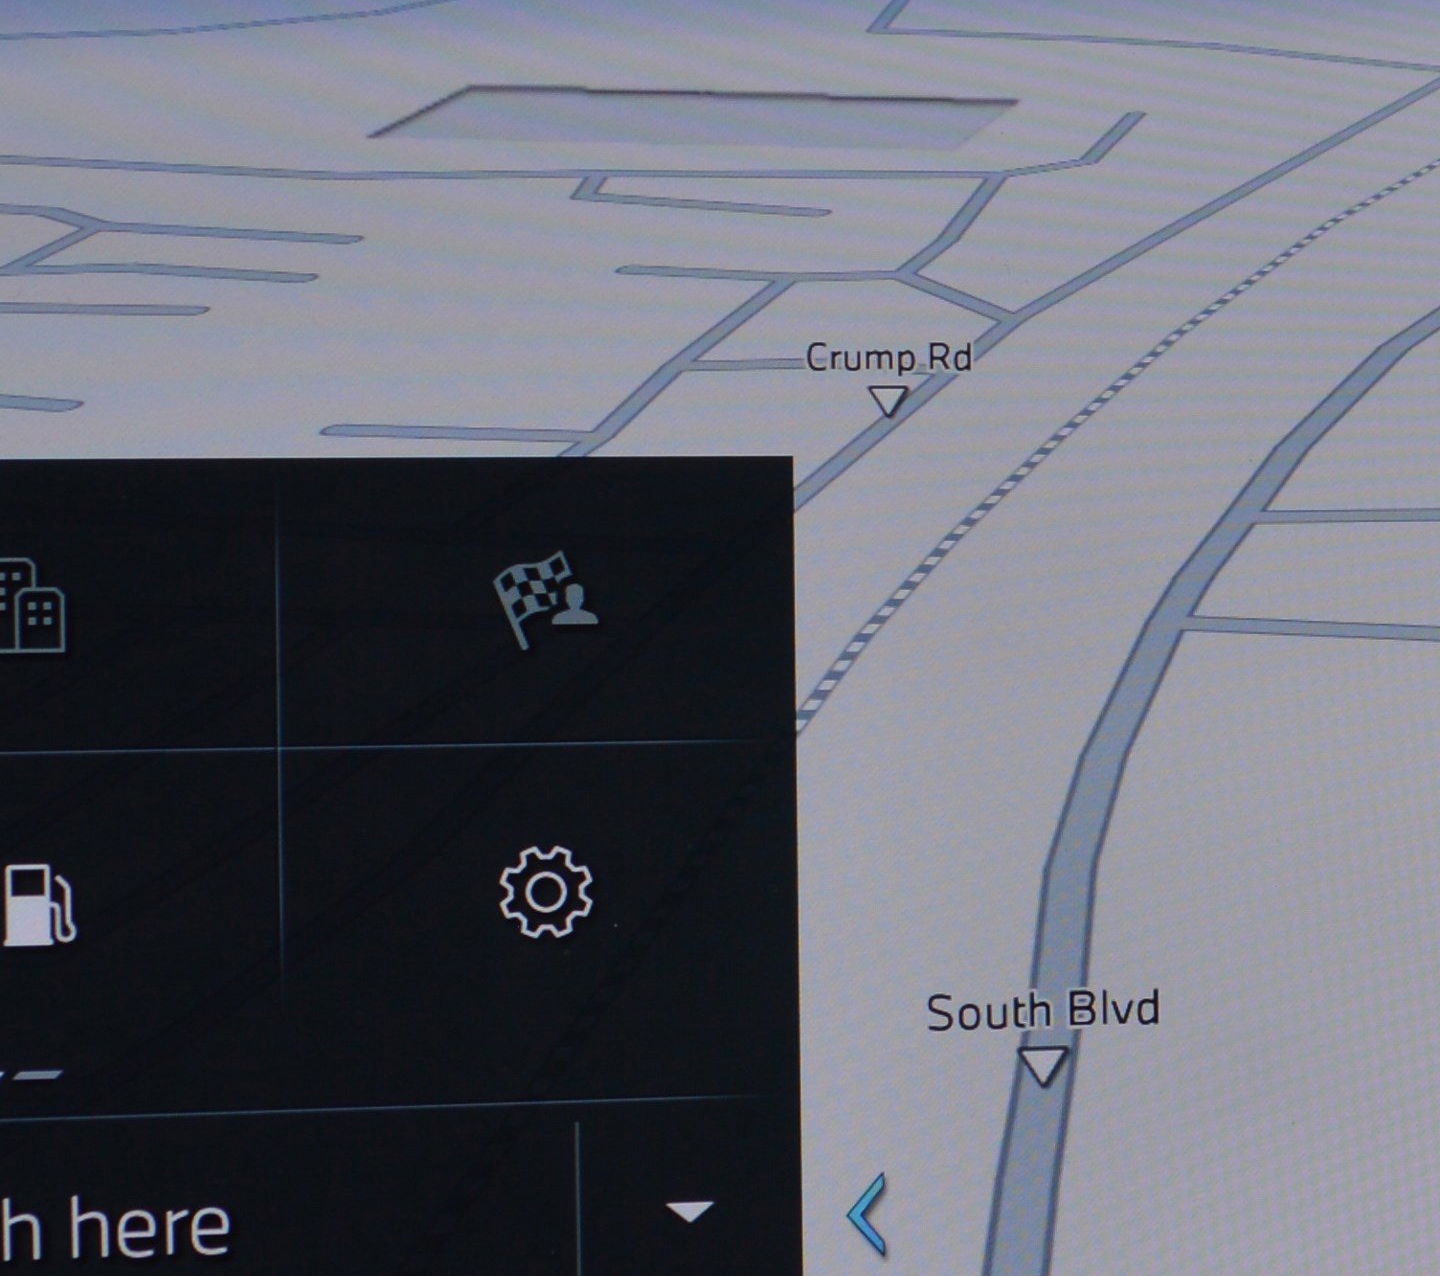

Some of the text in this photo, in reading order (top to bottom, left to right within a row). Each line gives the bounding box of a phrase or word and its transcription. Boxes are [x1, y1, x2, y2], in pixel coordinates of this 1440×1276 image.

[807, 342, 972, 376] Crump Rd
[927, 987, 1160, 1032] South Blvd
[71, 1195, 231, 1260] here
